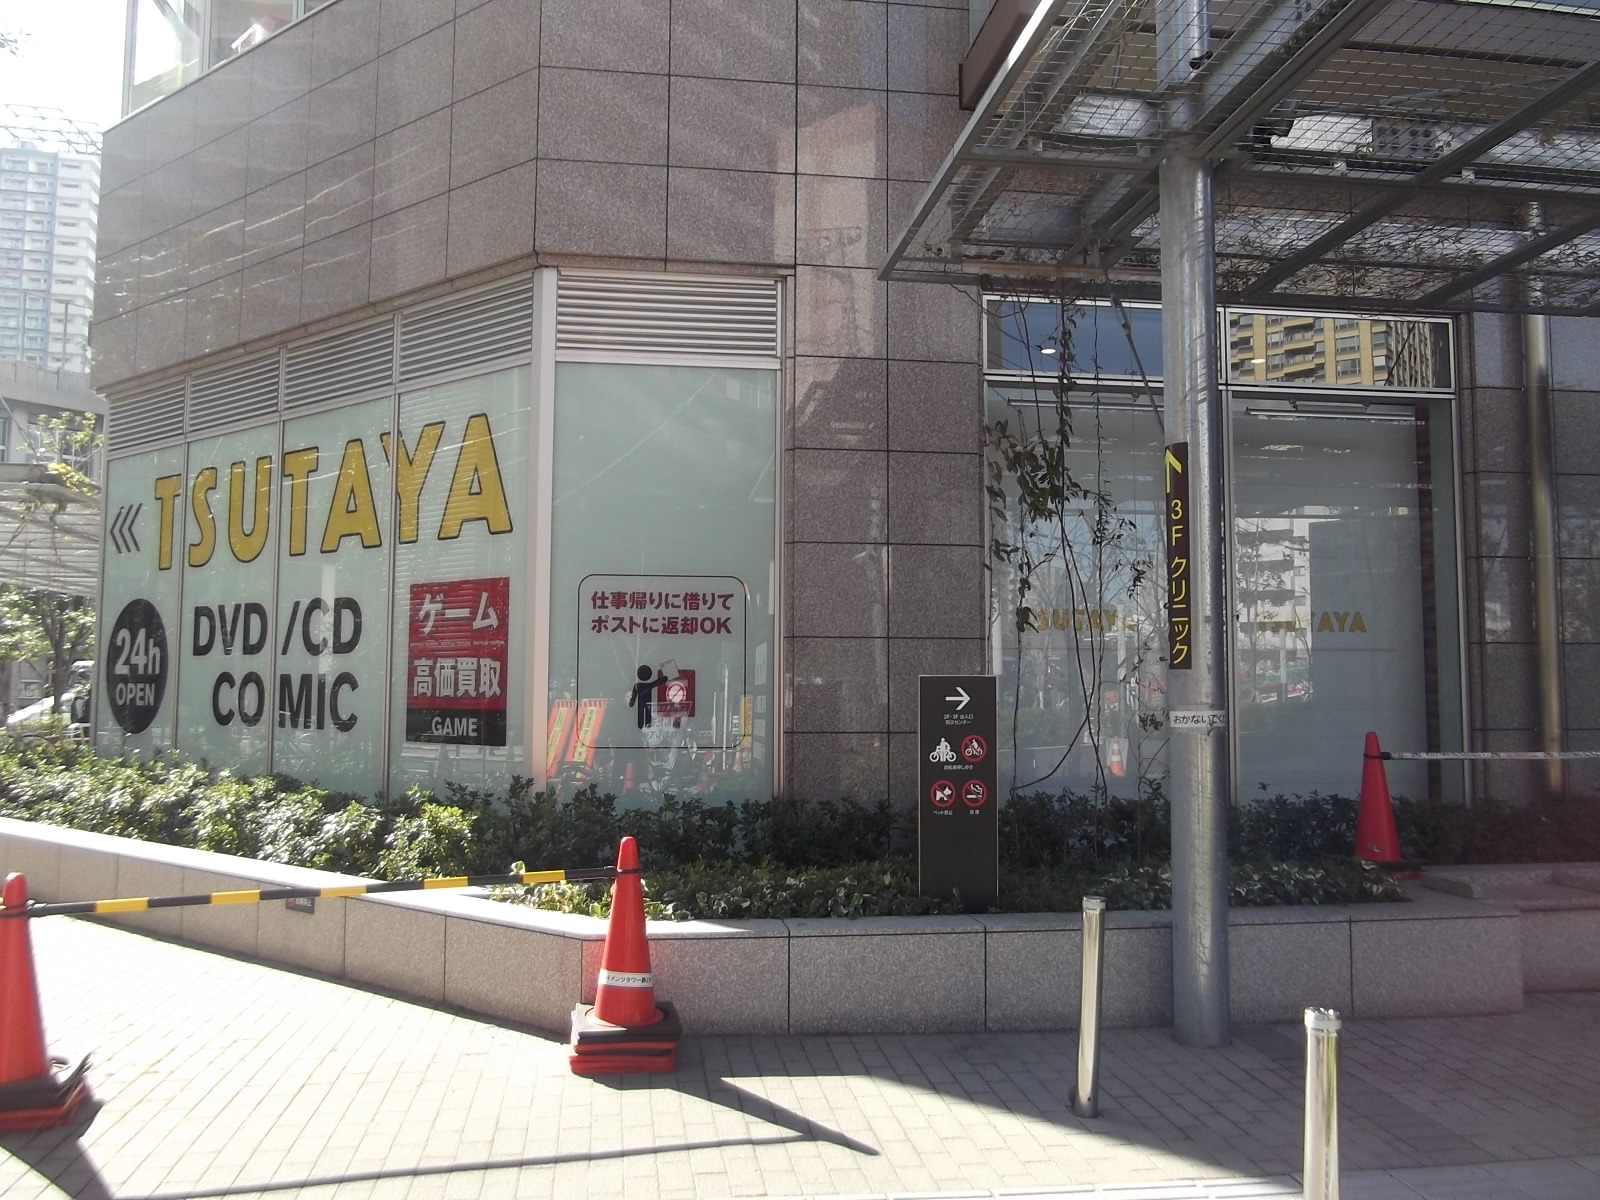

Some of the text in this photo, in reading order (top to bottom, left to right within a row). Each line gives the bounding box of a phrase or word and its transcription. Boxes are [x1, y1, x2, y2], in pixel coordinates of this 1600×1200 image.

[154, 413, 513, 570] TSUTAYA
[591, 591, 734, 611] 仕事帰りに借りて
[1171, 499, 1189, 664] 3F クリニック
[418, 591, 499, 636] ゲーム
[591, 614, 732, 635] ポストに返却OK
[114, 627, 161, 675] 24h
[116, 682, 156, 706] OPEN
[413, 656, 501, 698] 高価買取
[432, 716, 478, 737] GAME
